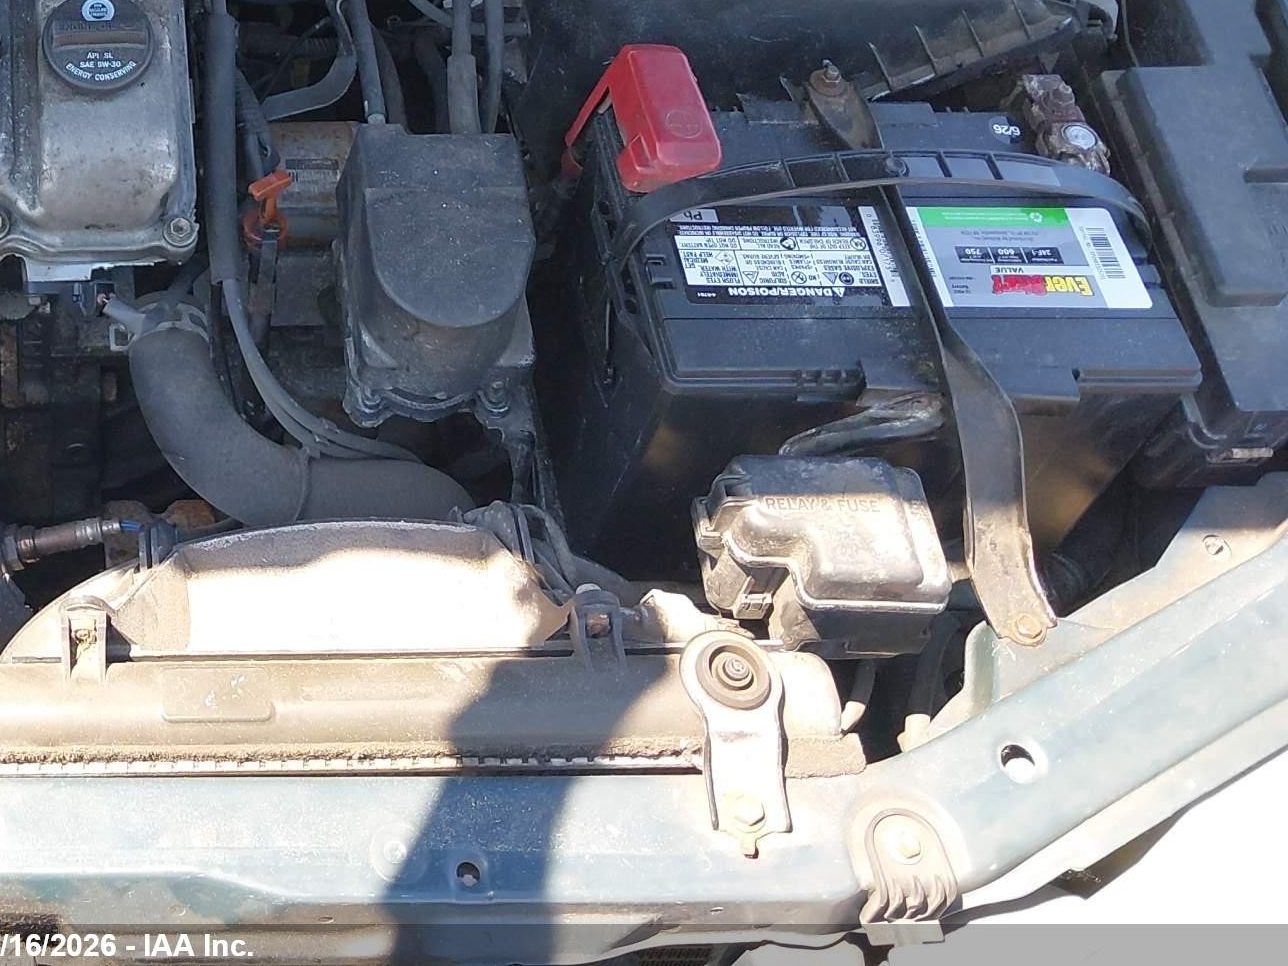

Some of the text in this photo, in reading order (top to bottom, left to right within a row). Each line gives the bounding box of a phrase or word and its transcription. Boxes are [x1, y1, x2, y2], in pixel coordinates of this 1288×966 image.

[66, 60, 137, 81] ENERGY CONSERVING
[993, 124, 1020, 136] 6/26
[683, 211, 703, 221] Pb
[727, 287, 833, 297] DANGER/POISON
[764, 497, 881, 513] RELAY & FUSE
